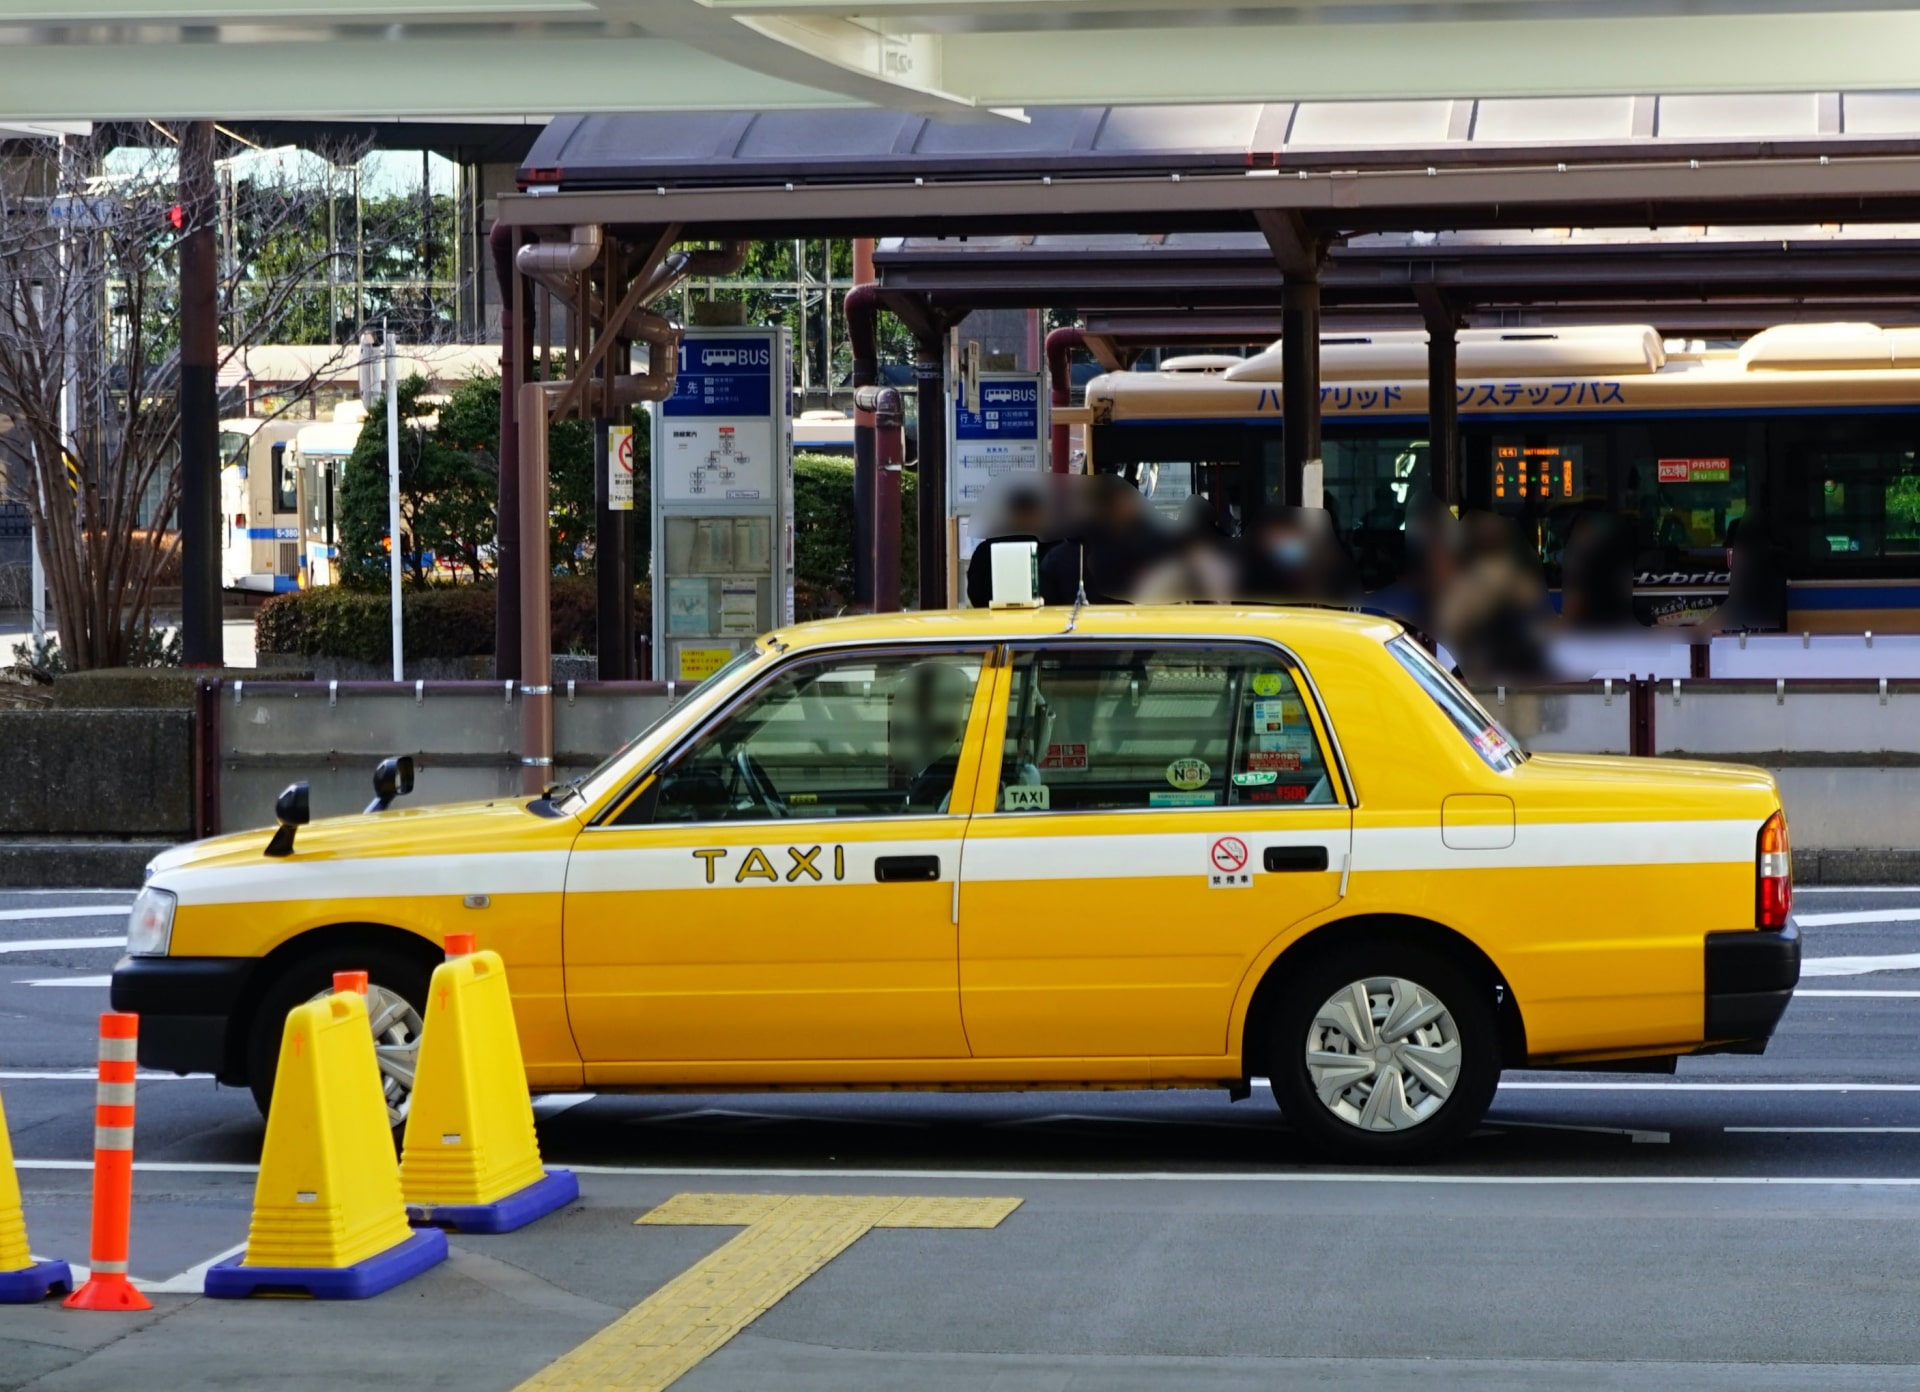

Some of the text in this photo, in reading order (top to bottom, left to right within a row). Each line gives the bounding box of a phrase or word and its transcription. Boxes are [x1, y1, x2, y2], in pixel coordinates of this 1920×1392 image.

[738, 349, 769, 365] BUS
[1012, 389, 1036, 402] BUS
[1257, 381, 1625, 412] ハブリッド ンステップバス
[1692, 461, 1727, 469] PASMO
[1693, 472, 1725, 480] Sua
[1010, 791, 1044, 804] TAXI
[692, 844, 845, 884] TAXI
[1212, 874, 1249, 885] 禁煙車
